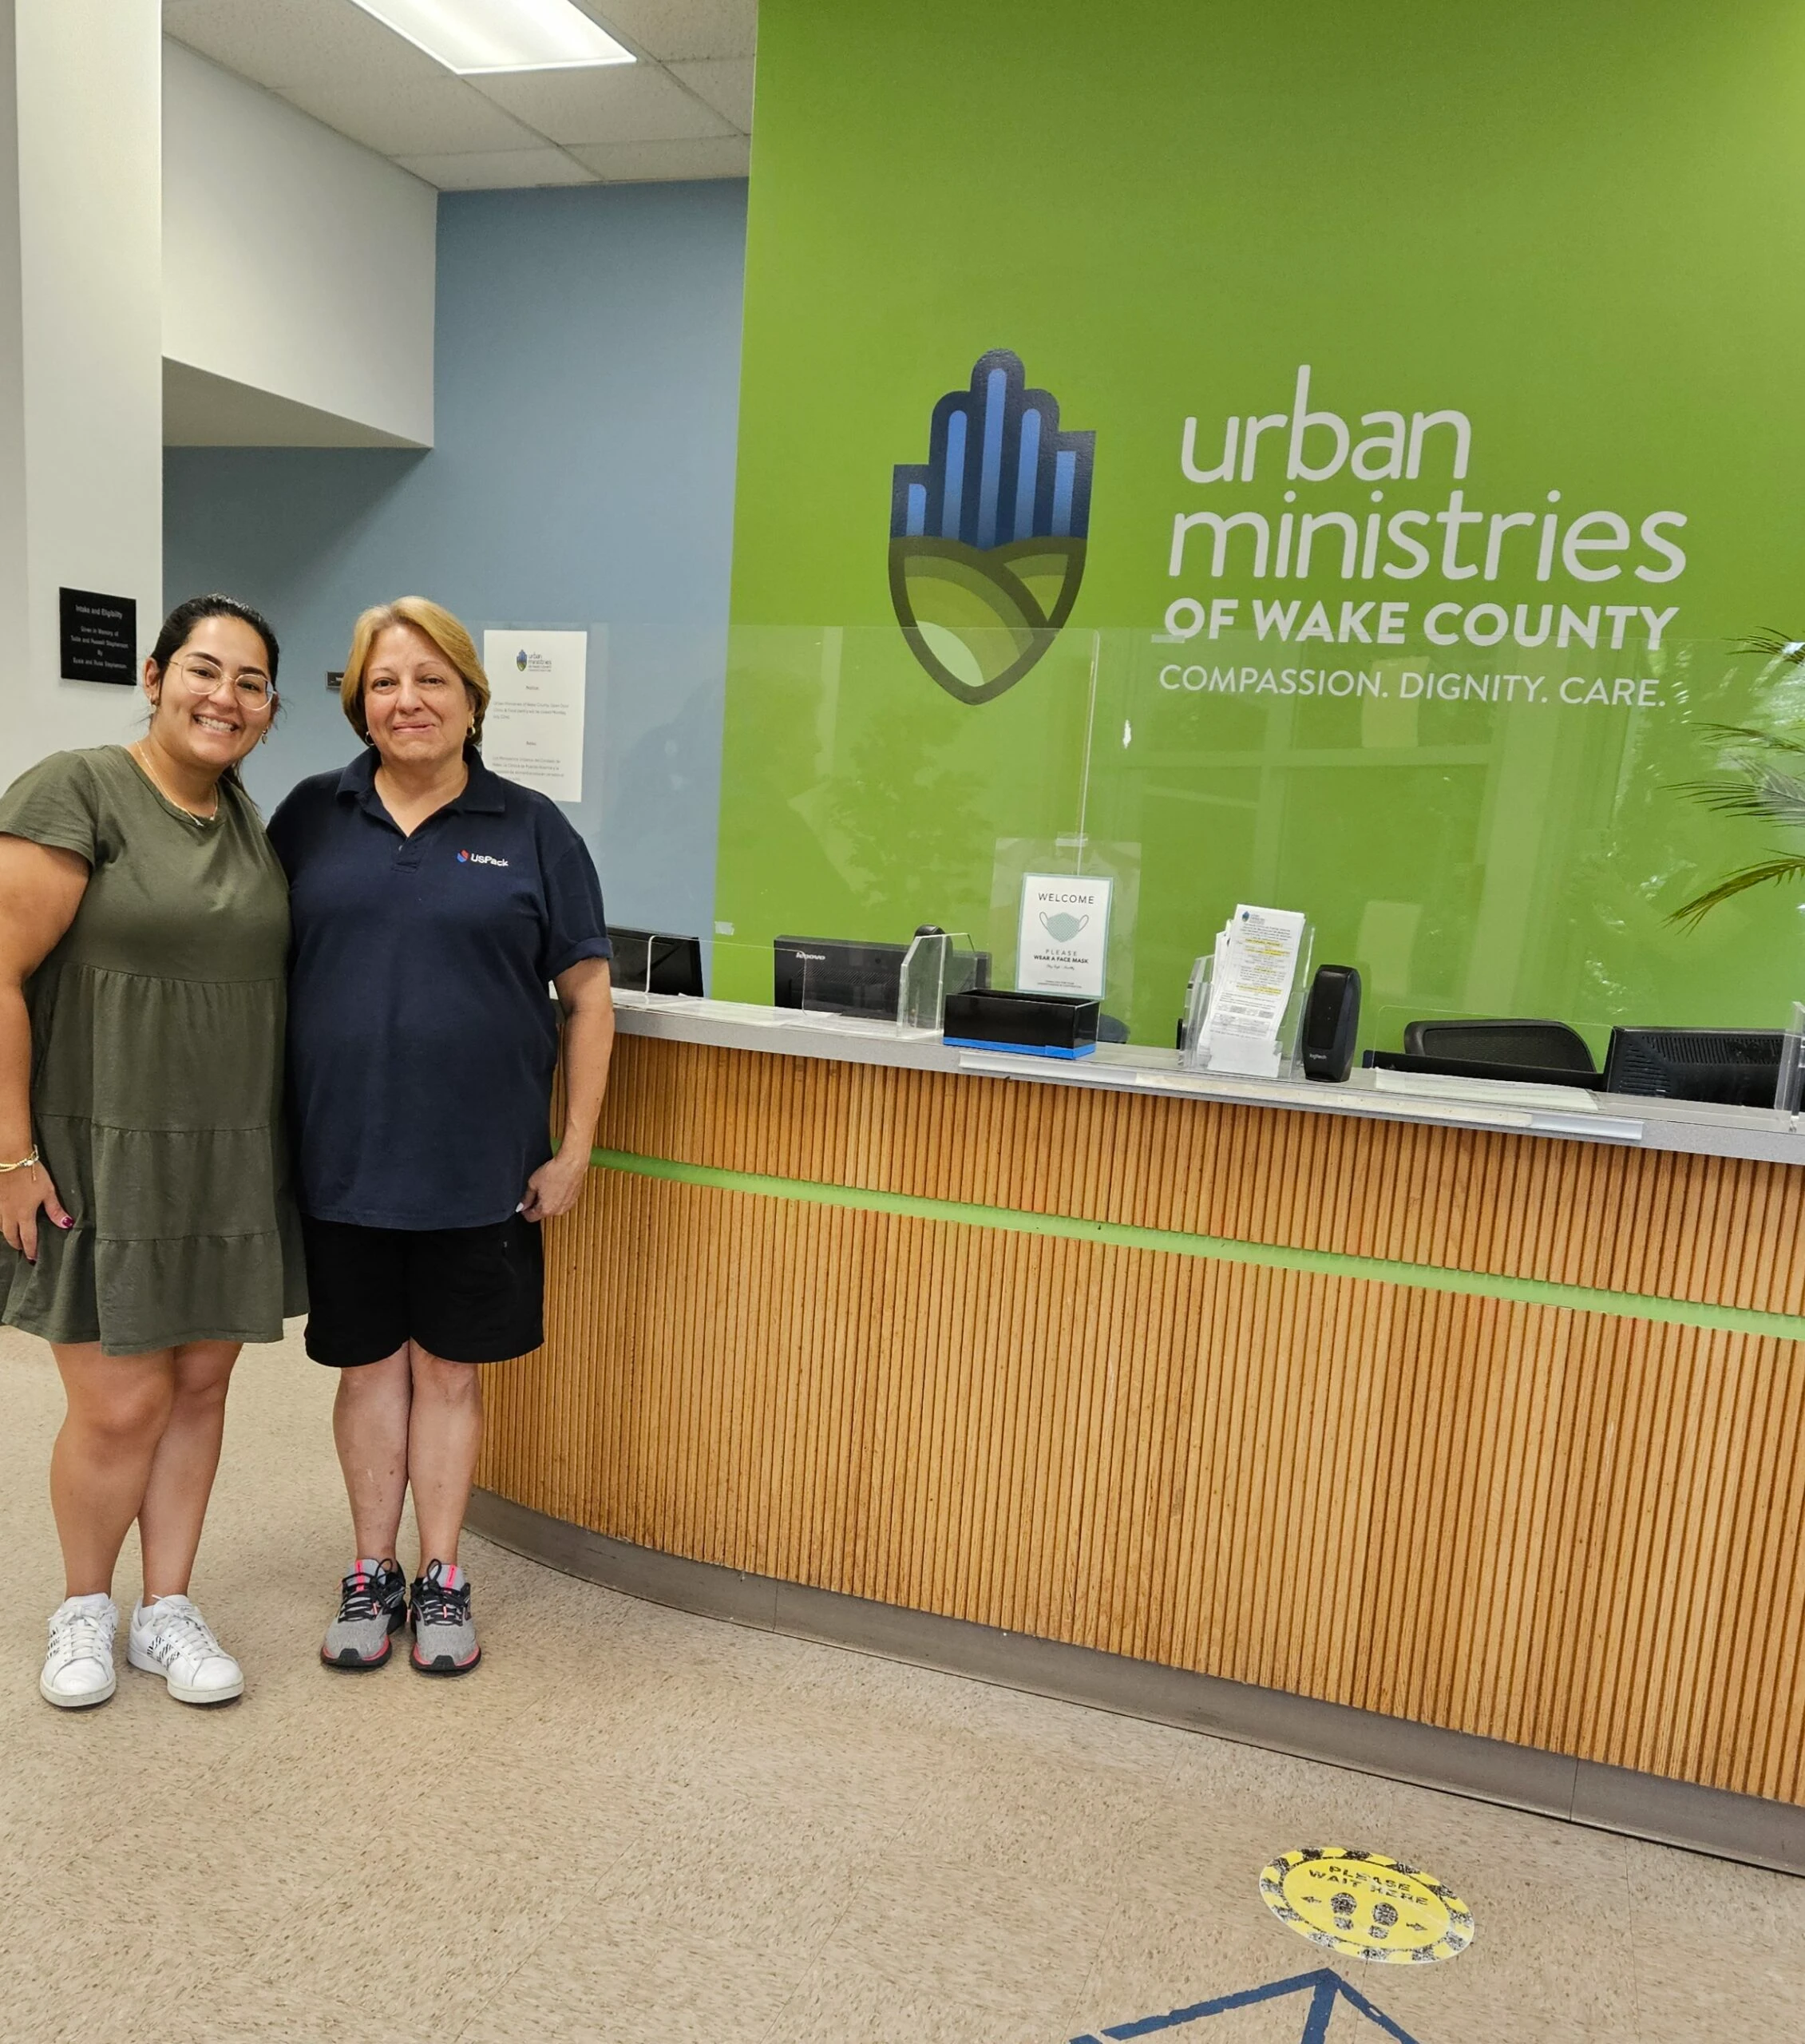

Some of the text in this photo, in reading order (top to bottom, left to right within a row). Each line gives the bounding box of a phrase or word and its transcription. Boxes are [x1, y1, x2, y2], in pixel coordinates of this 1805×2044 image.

[1181, 364, 1472, 484] urban
[1169, 489, 1688, 584] ministries
[1165, 598, 1680, 651] OF WAKE COUNTY
[1159, 664, 1666, 707] COMPASSION. DIGNITY. CARE.
[470, 853, 509, 867] USPack
[1038, 893, 1094, 904] WELCOME
[1309, 1869, 1429, 1906] WAIT HERE
[1329, 1865, 1411, 1891] PLEASE
